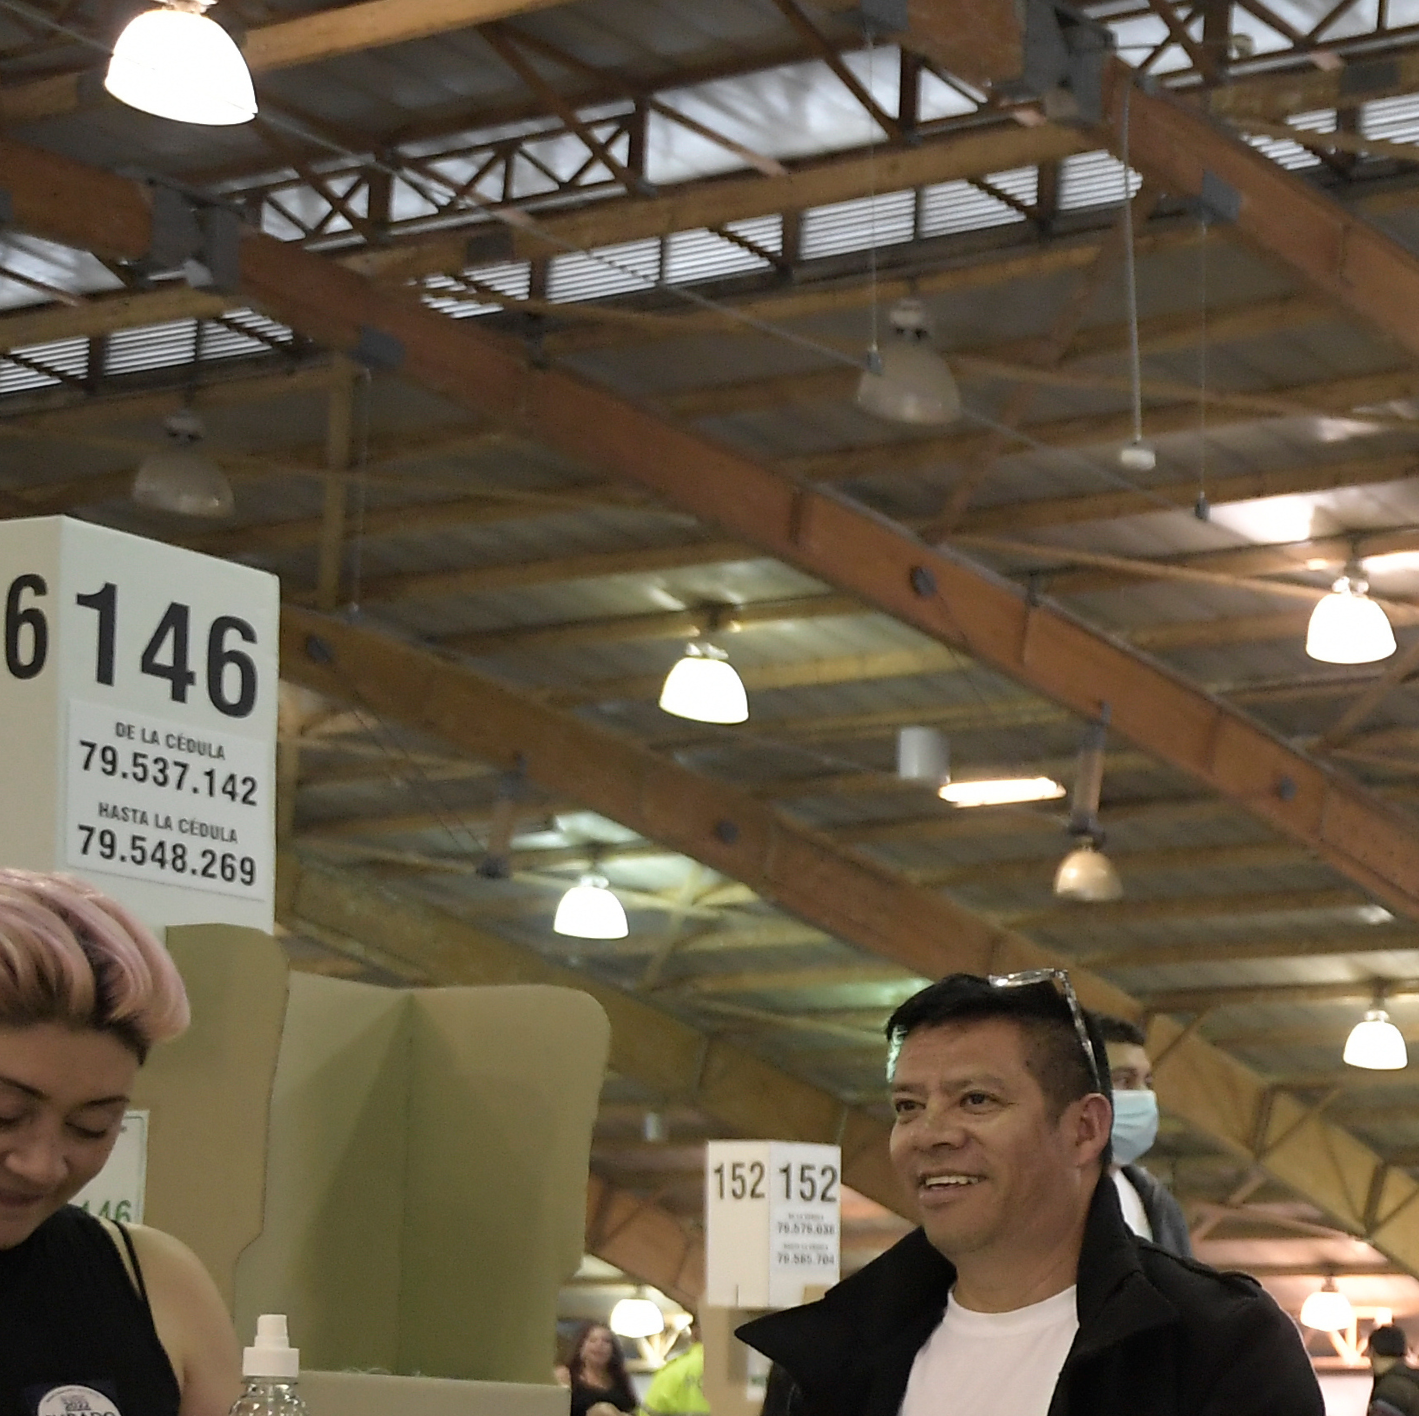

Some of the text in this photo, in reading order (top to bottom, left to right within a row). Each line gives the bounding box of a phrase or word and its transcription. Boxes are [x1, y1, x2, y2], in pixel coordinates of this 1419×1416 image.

[76, 582, 259, 718] 146
[115, 721, 226, 761] DE LA CÉDULA
[79, 739, 258, 806] 79.537.142
[98, 801, 239, 844] HASTA LA CÉDULA
[77, 823, 257, 887] 79.548.269
[713, 1161, 766, 1201] 152
[779, 1162, 838, 1202] 152
